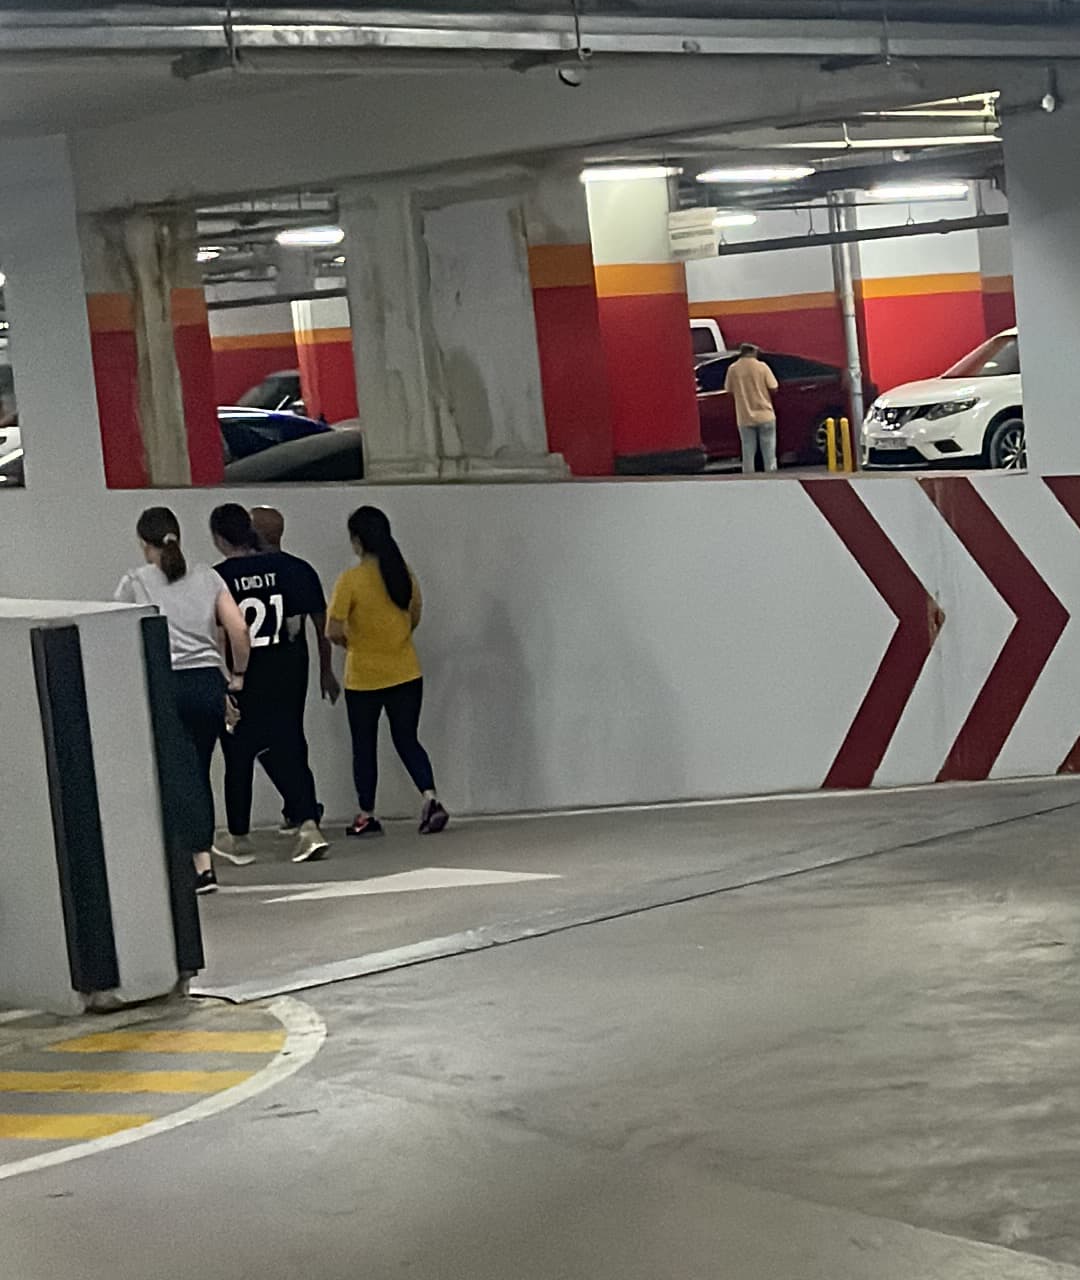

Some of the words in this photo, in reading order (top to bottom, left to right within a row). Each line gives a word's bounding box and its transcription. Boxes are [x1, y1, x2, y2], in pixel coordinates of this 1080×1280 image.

[240, 575, 263, 591] DID
[264, 572, 277, 588] IT
[238, 593, 284, 648] 21
